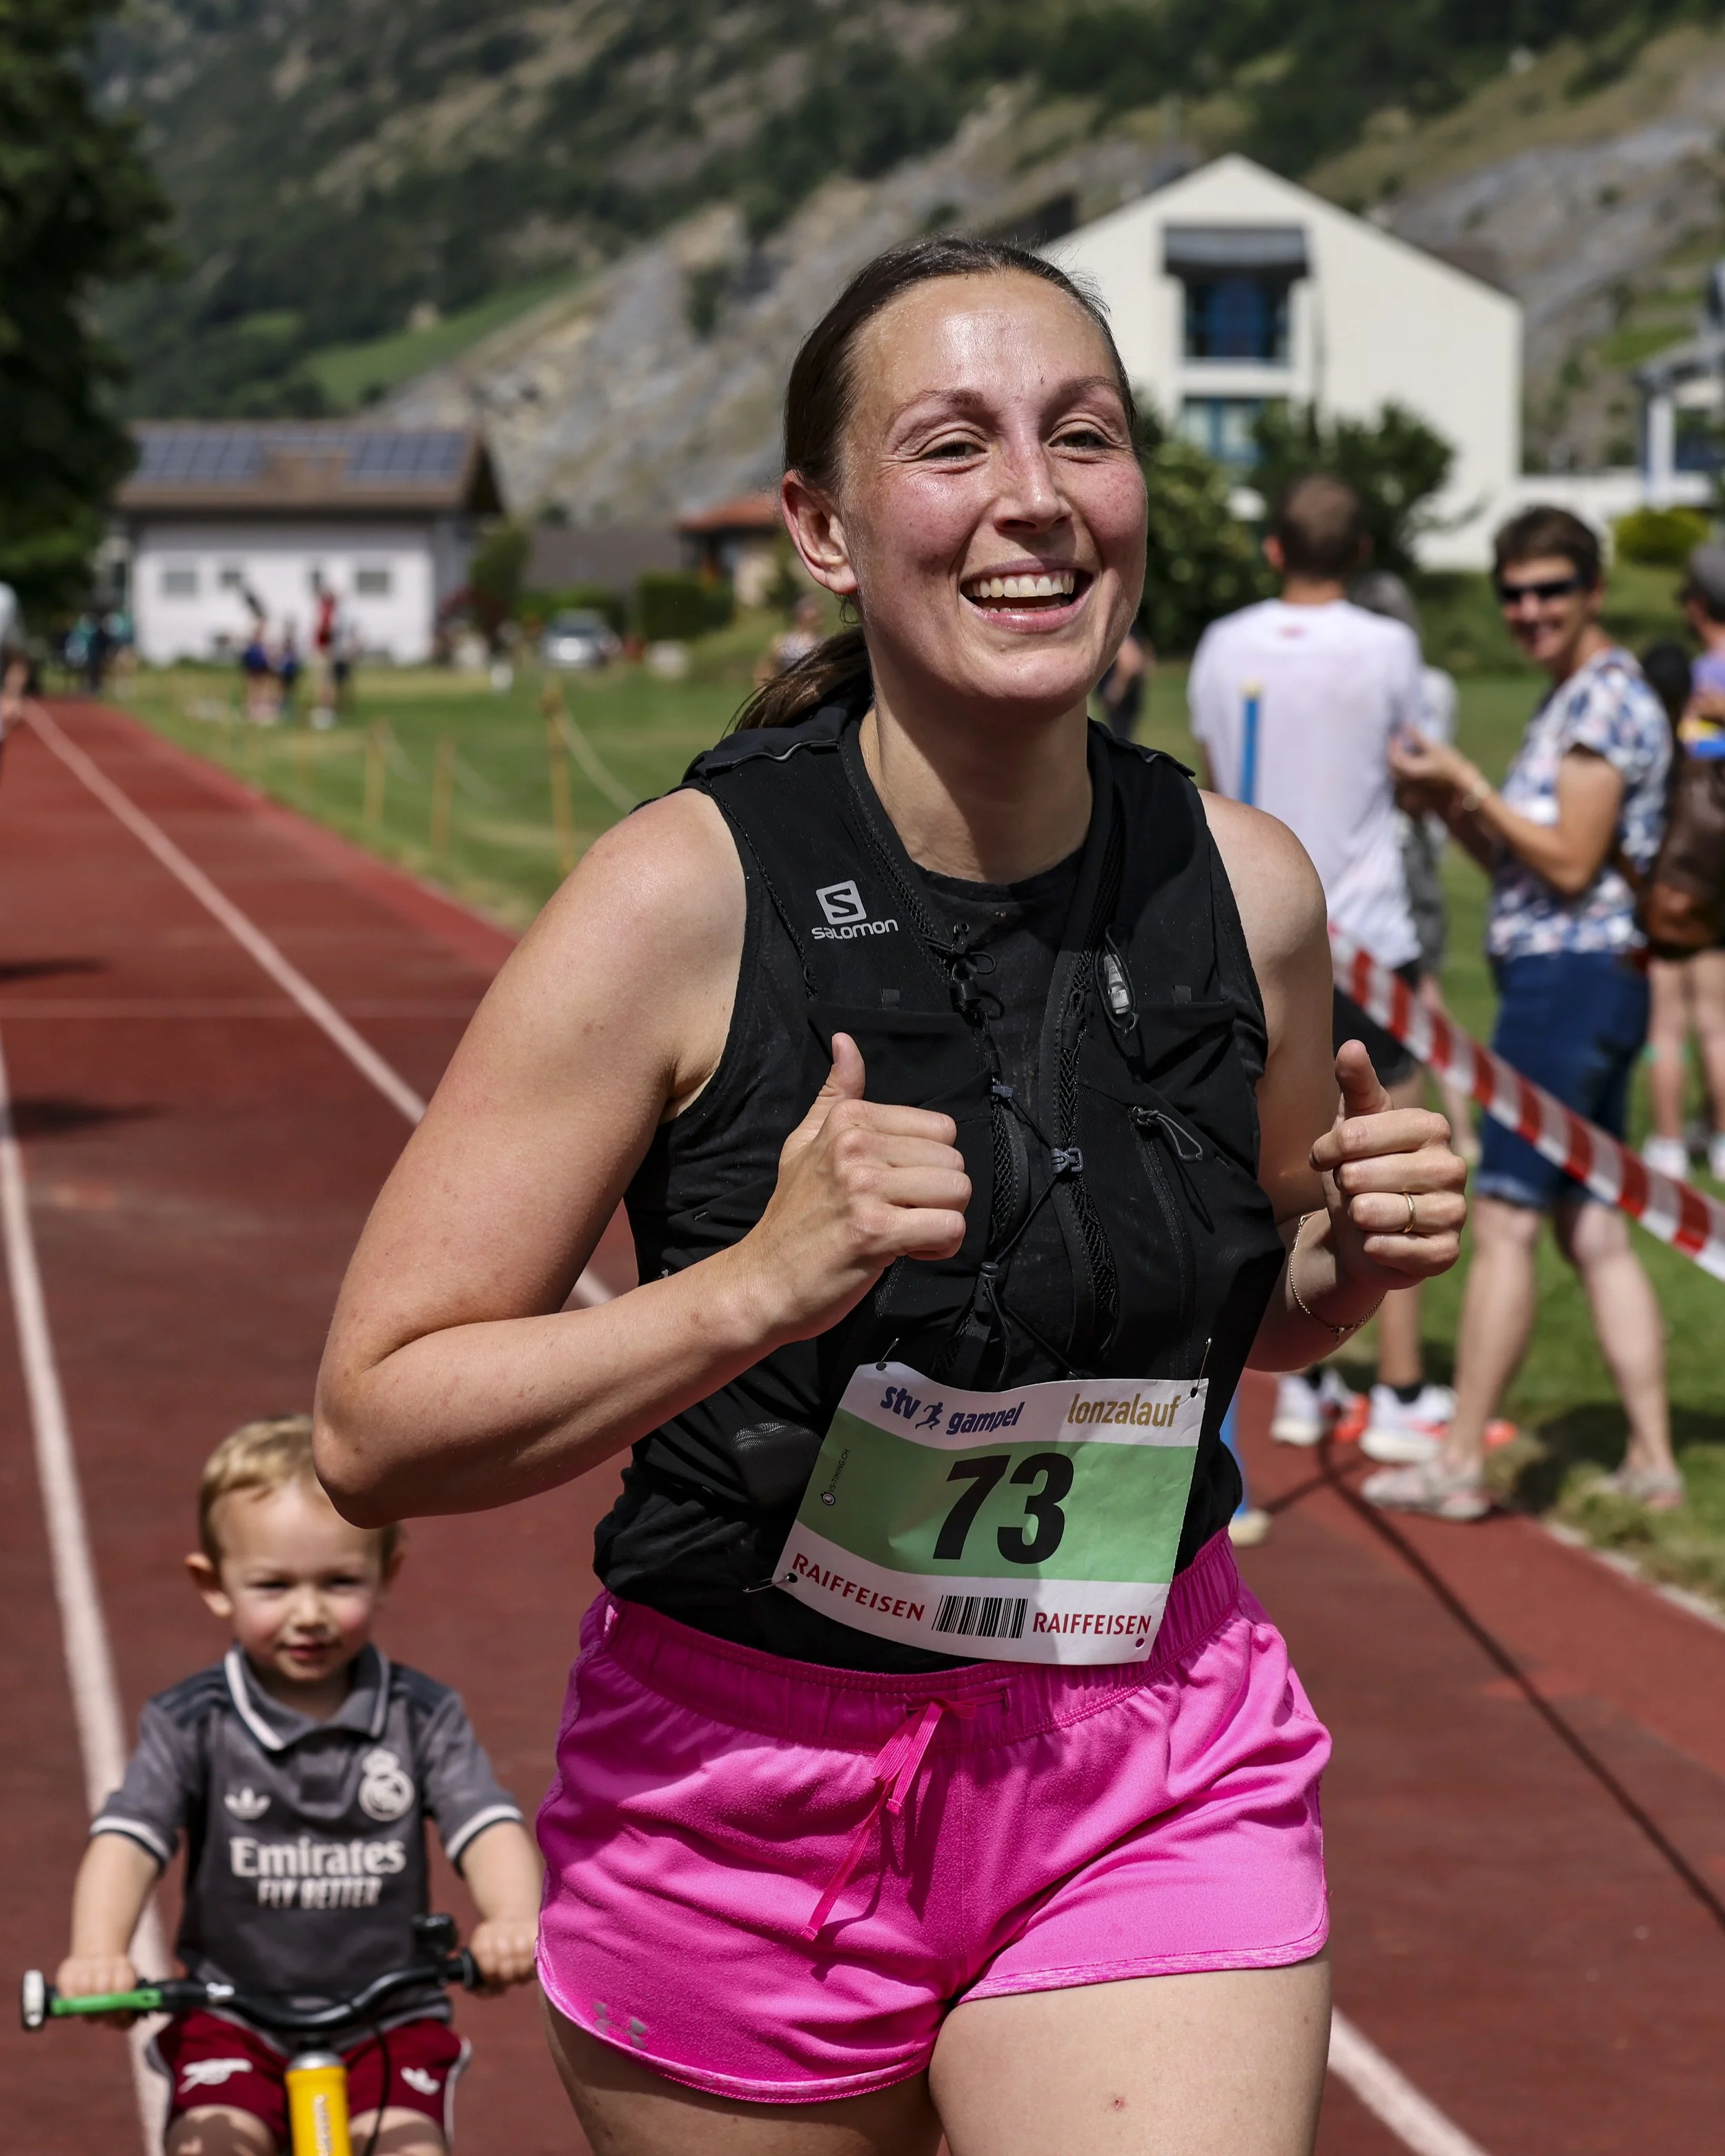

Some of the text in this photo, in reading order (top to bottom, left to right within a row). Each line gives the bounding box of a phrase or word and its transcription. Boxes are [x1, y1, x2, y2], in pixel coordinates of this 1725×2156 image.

[880, 1386, 1025, 1435] stv gampel
[1067, 1394, 1181, 1427] lonzalauf
[932, 1452, 1074, 1565] 73
[791, 1552, 925, 1622] RAIFFEISEN
[1032, 1612, 1152, 1634] RAIFFEISEN
[229, 1835, 407, 1877] Emirates
